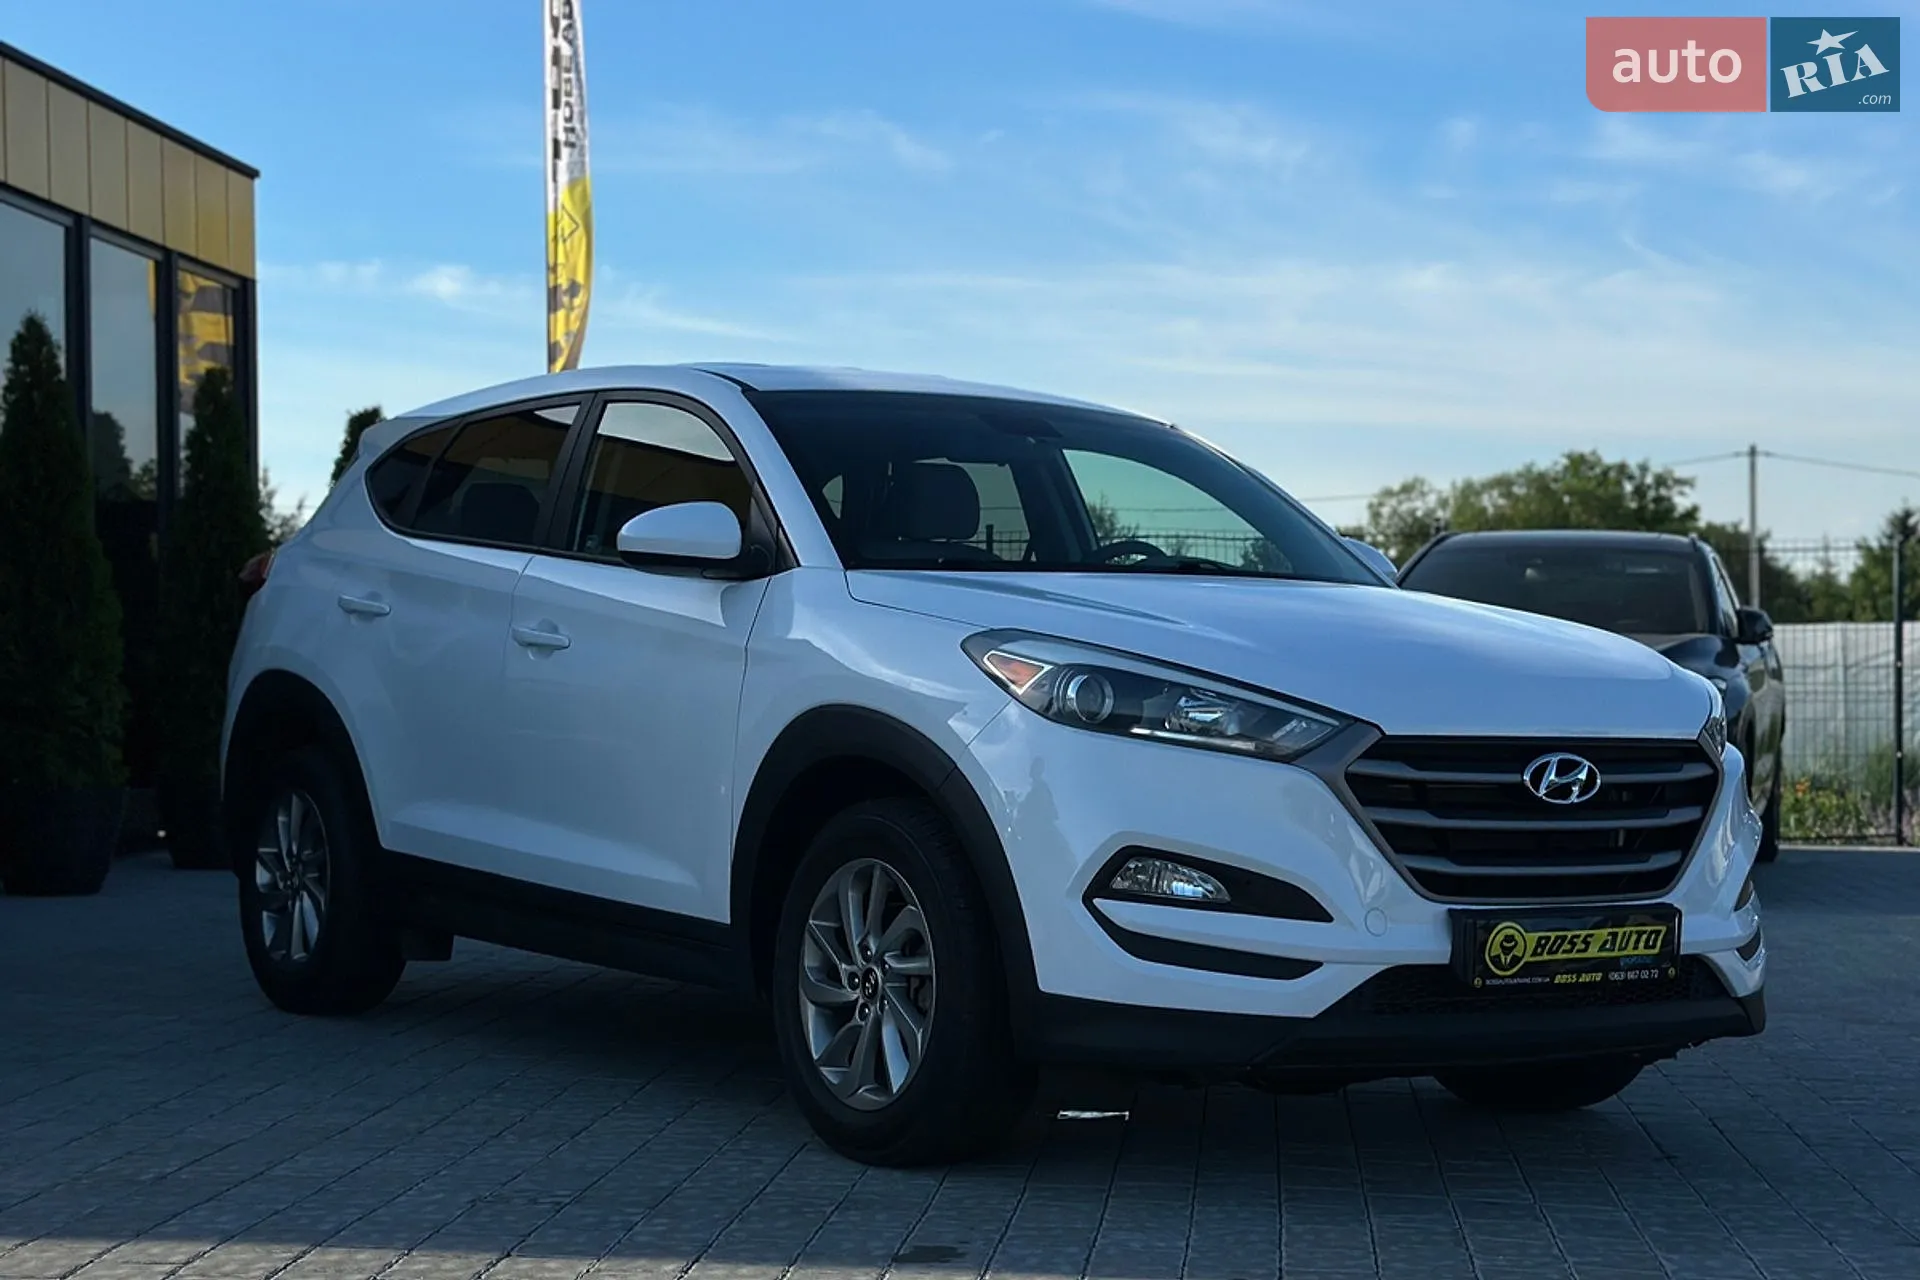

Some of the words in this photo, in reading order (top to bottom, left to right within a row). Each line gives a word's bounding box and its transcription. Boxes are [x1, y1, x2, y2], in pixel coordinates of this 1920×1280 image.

[1530, 934, 1594, 957] BOSS
[1597, 929, 1662, 952] AUTO
[1554, 974, 1578, 984] BOSS
[1578, 972, 1602, 983] AUTO
